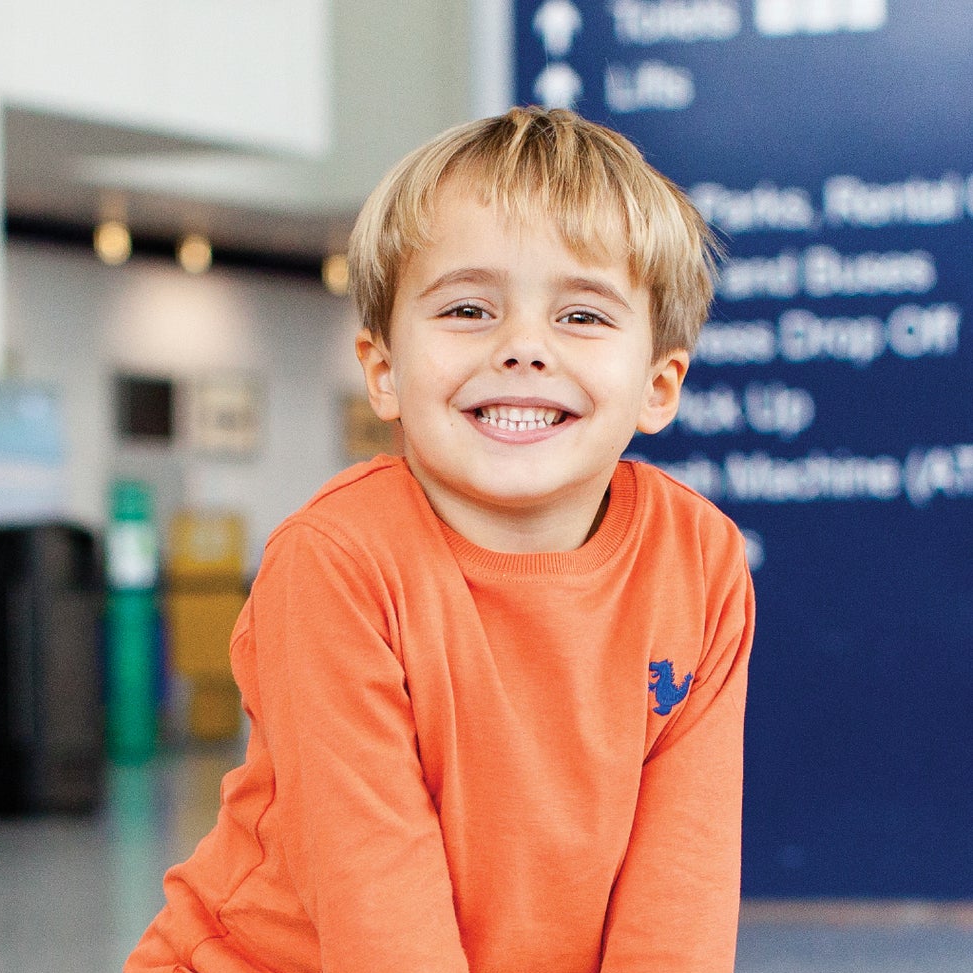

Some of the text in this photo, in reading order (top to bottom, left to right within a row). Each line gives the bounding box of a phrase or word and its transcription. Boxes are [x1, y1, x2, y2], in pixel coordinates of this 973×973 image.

[605, 60, 694, 111] Lifts
[824, 176, 964, 225] Rental
[777, 309, 884, 366] Drop
[887, 304, 960, 357] Off
[744, 383, 814, 439] Up
[725, 450, 902, 501] Machine
